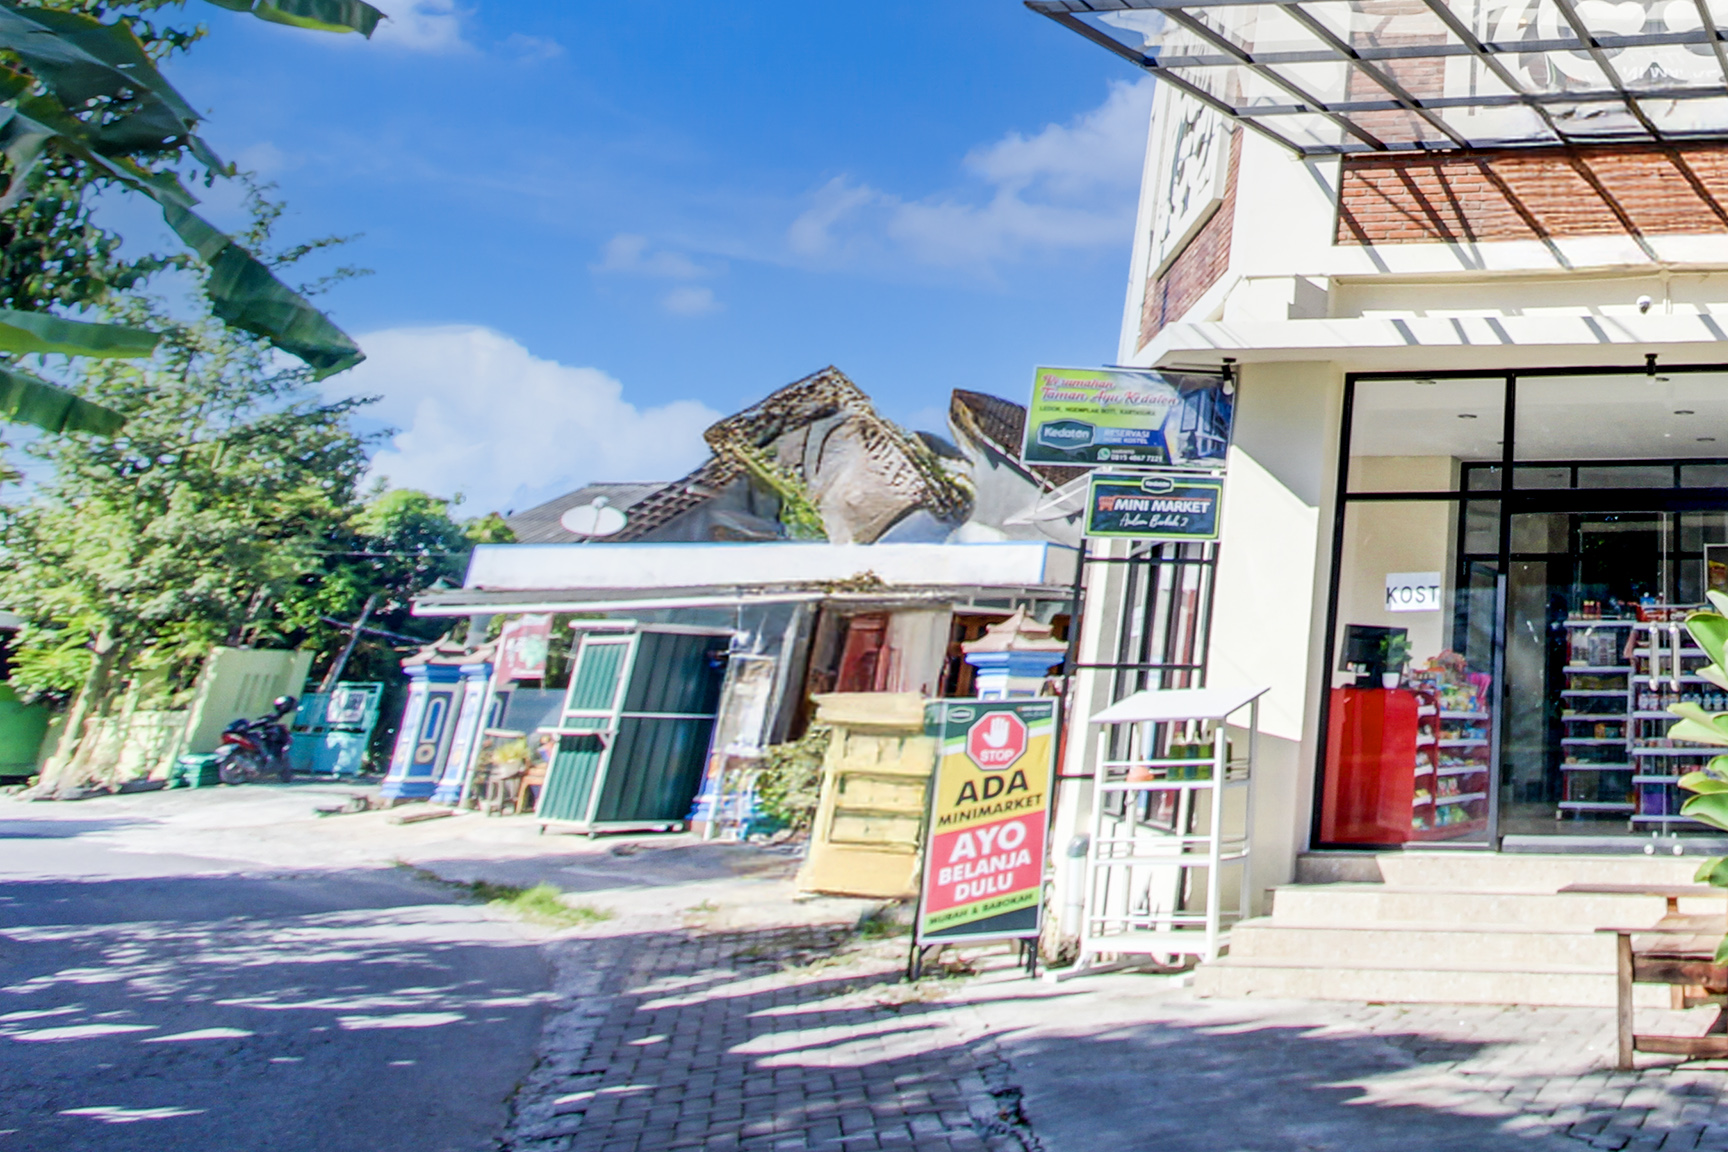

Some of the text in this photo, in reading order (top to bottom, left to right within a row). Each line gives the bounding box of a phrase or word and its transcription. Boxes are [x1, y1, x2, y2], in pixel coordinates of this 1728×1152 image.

[1042, 387, 1086, 400] Taman
[1090, 390, 1120, 405] Ayu
[1103, 429, 1150, 438] RESERVASI
[1113, 498, 1211, 514] MINI MARKET
[1386, 585, 1439, 604] KOST
[979, 749, 1015, 763] STOP
[954, 769, 1029, 808] ADA
[938, 793, 1043, 827] MINIMARKET
[948, 820, 1027, 864] AYO
[938, 848, 1032, 886] BELANJA
[953, 871, 1014, 902] DULU
